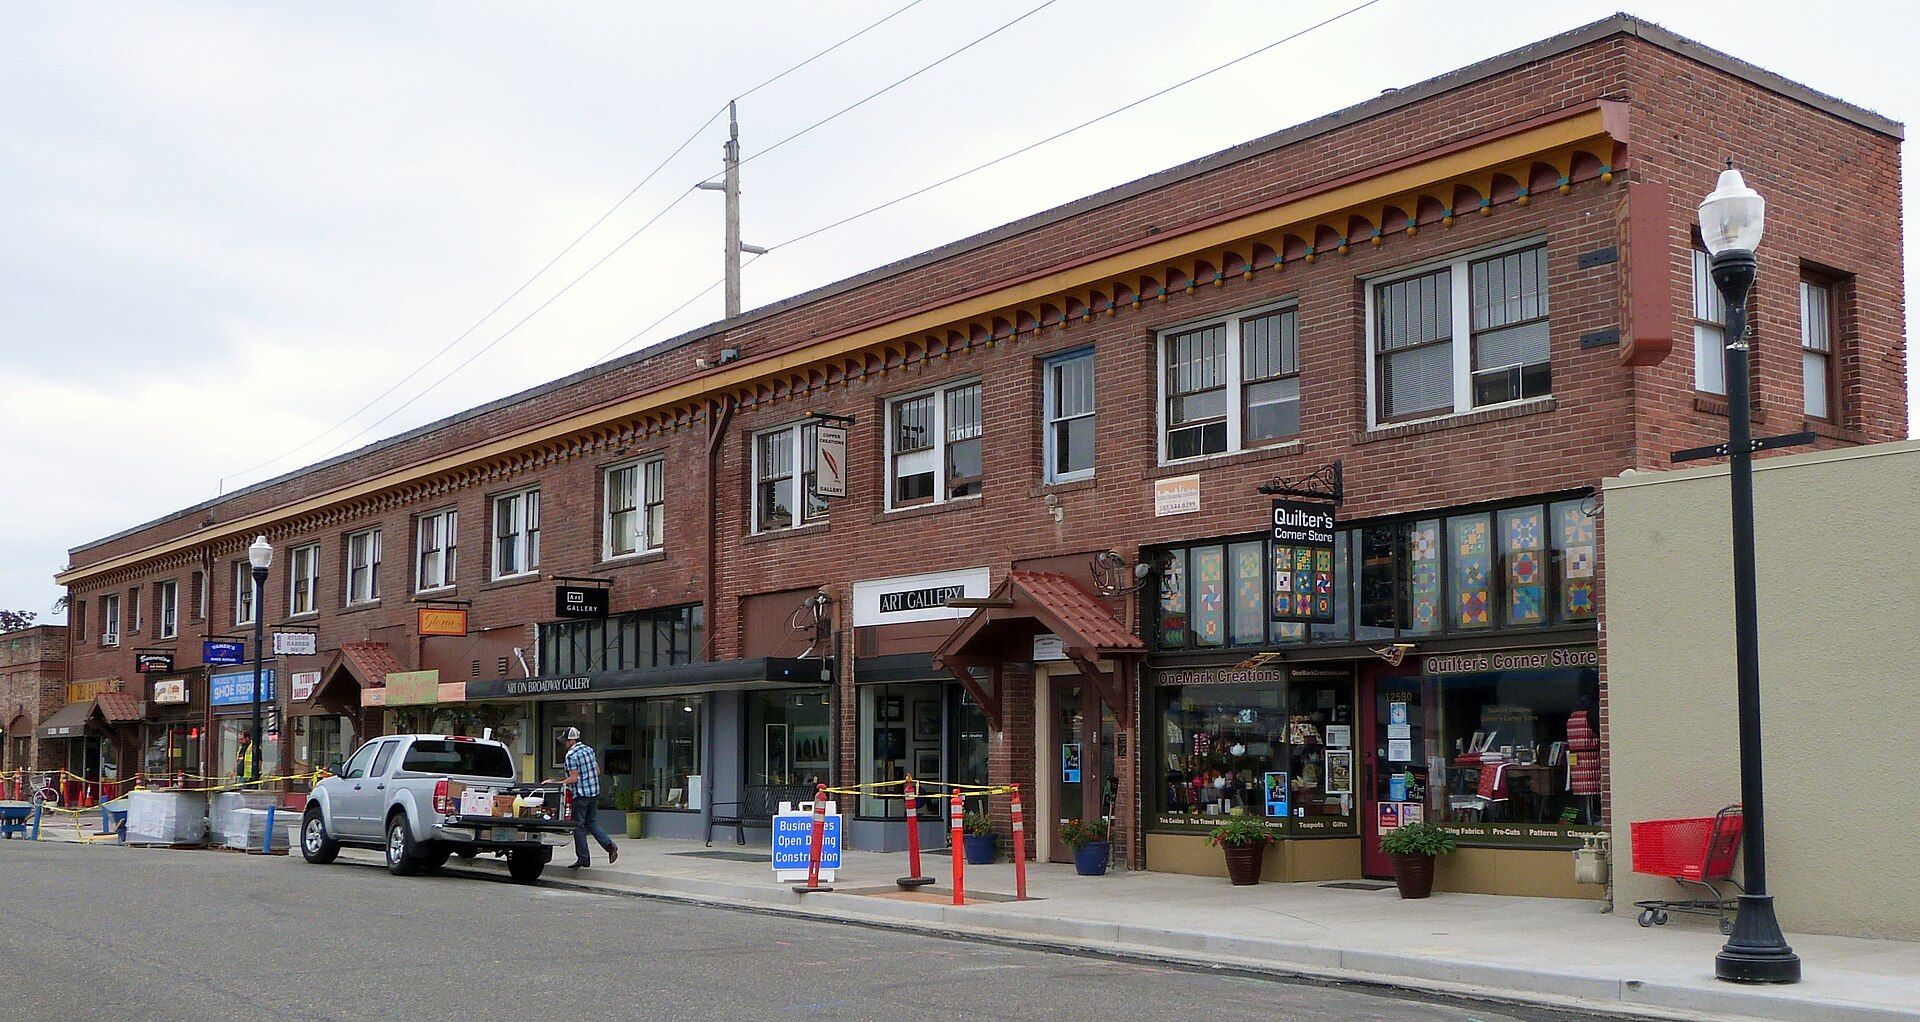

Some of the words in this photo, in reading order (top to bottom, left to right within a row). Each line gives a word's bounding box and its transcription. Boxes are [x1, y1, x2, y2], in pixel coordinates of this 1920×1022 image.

[1274, 507, 1333, 529] Quilter's
[1274, 527, 1307, 540] Corner
[1308, 529, 1333, 542] Store
[881, 593, 904, 611] ART
[907, 586, 961, 609] GALLERY
[425, 613, 462, 628] Gloria's
[1492, 651, 1548, 670] Corner
[1551, 648, 1598, 667] Store
[1158, 670, 1214, 685] OneMark
[1217, 668, 1281, 683] Creations
[214, 684, 235, 700] SHOE
[507, 682, 517, 694] ART
[517, 681, 528, 694] ON
[528, 679, 562, 693] BROADWAY
[562, 677, 591, 691] GALLERY
[1385, 692, 1412, 702] 12580
[779, 820, 835, 831] Businees
[1298, 821, 1324, 829] Teapots
[1460, 827, 1485, 835] Fabrics
[1492, 828, 1520, 836] Pre-Cuts
[1529, 828, 1558, 837] Patterns
[778, 835, 802, 848] Open
[805, 835, 836, 848] Ding
[775, 851, 838, 863] Constrtion
